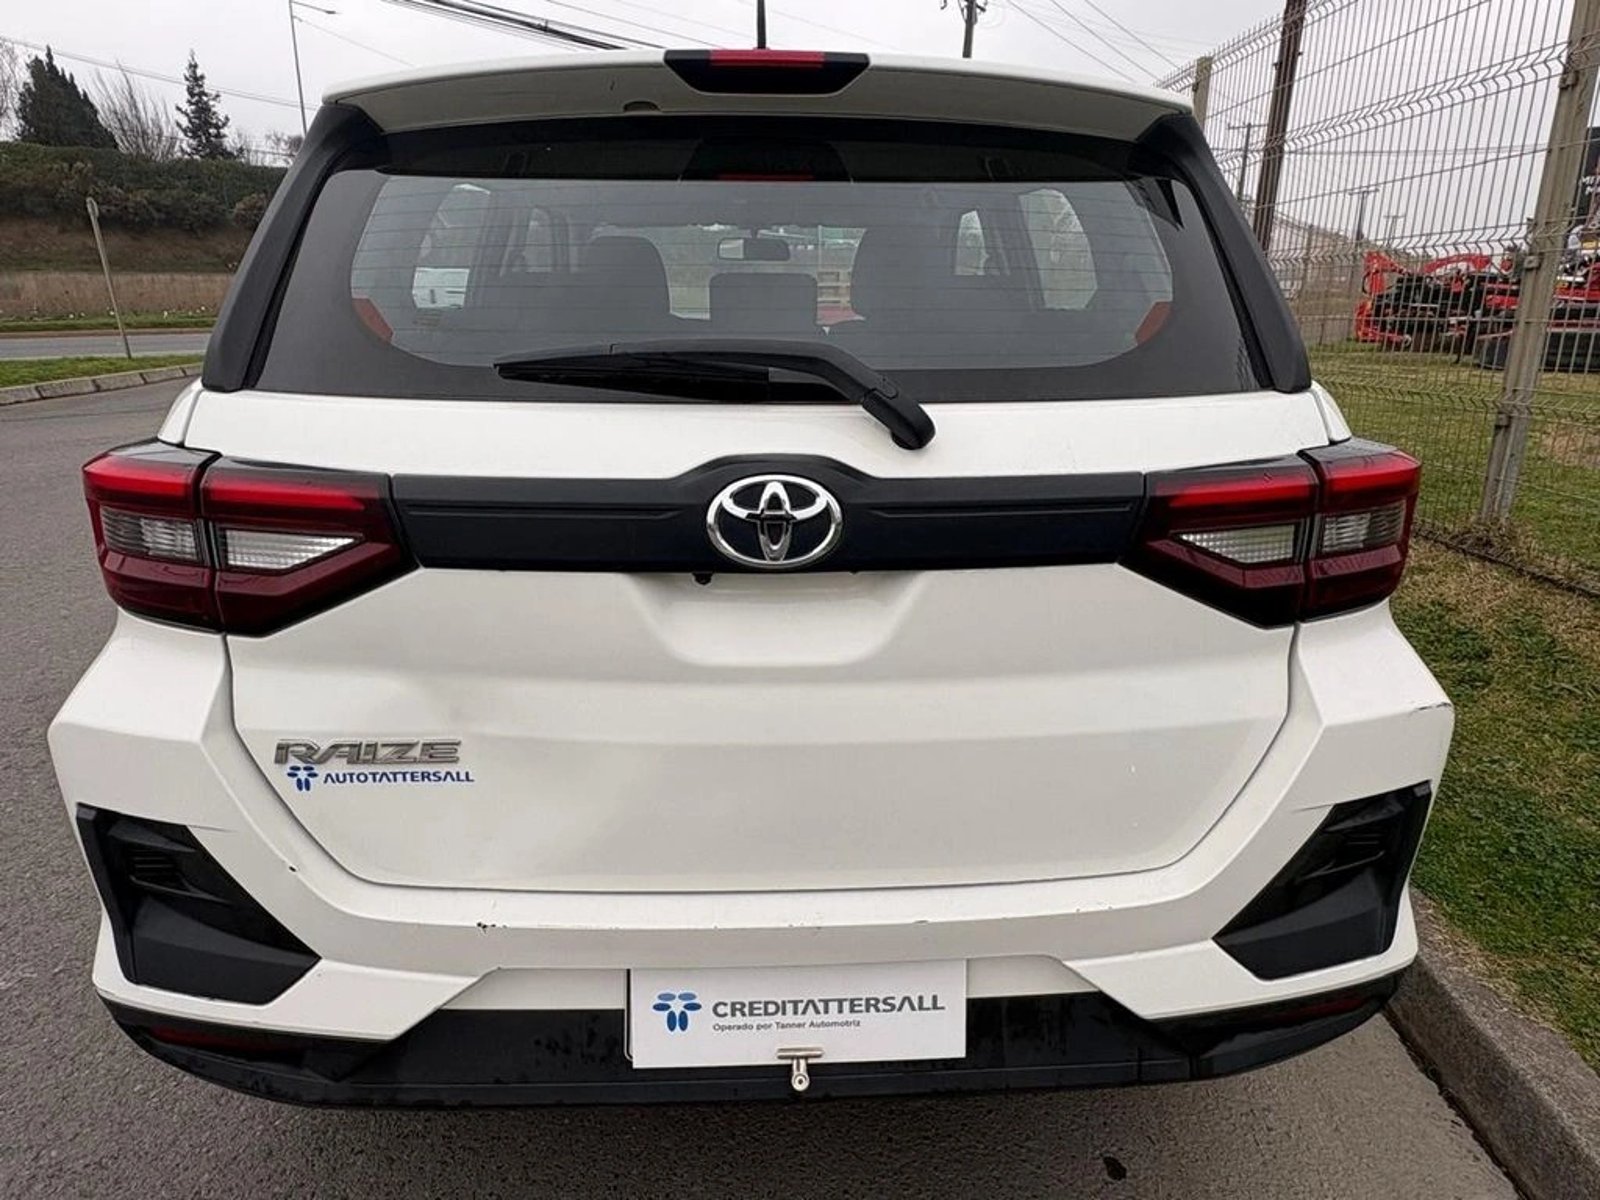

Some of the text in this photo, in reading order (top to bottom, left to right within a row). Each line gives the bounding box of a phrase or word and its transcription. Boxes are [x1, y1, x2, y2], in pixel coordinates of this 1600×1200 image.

[273, 738, 462, 765] RAIZE
[323, 771, 475, 785] AUTOTATTERSALL
[712, 994, 946, 1018] CREDITATTERSALL
[712, 1019, 861, 1032] Operado por Tanner Automotriz
